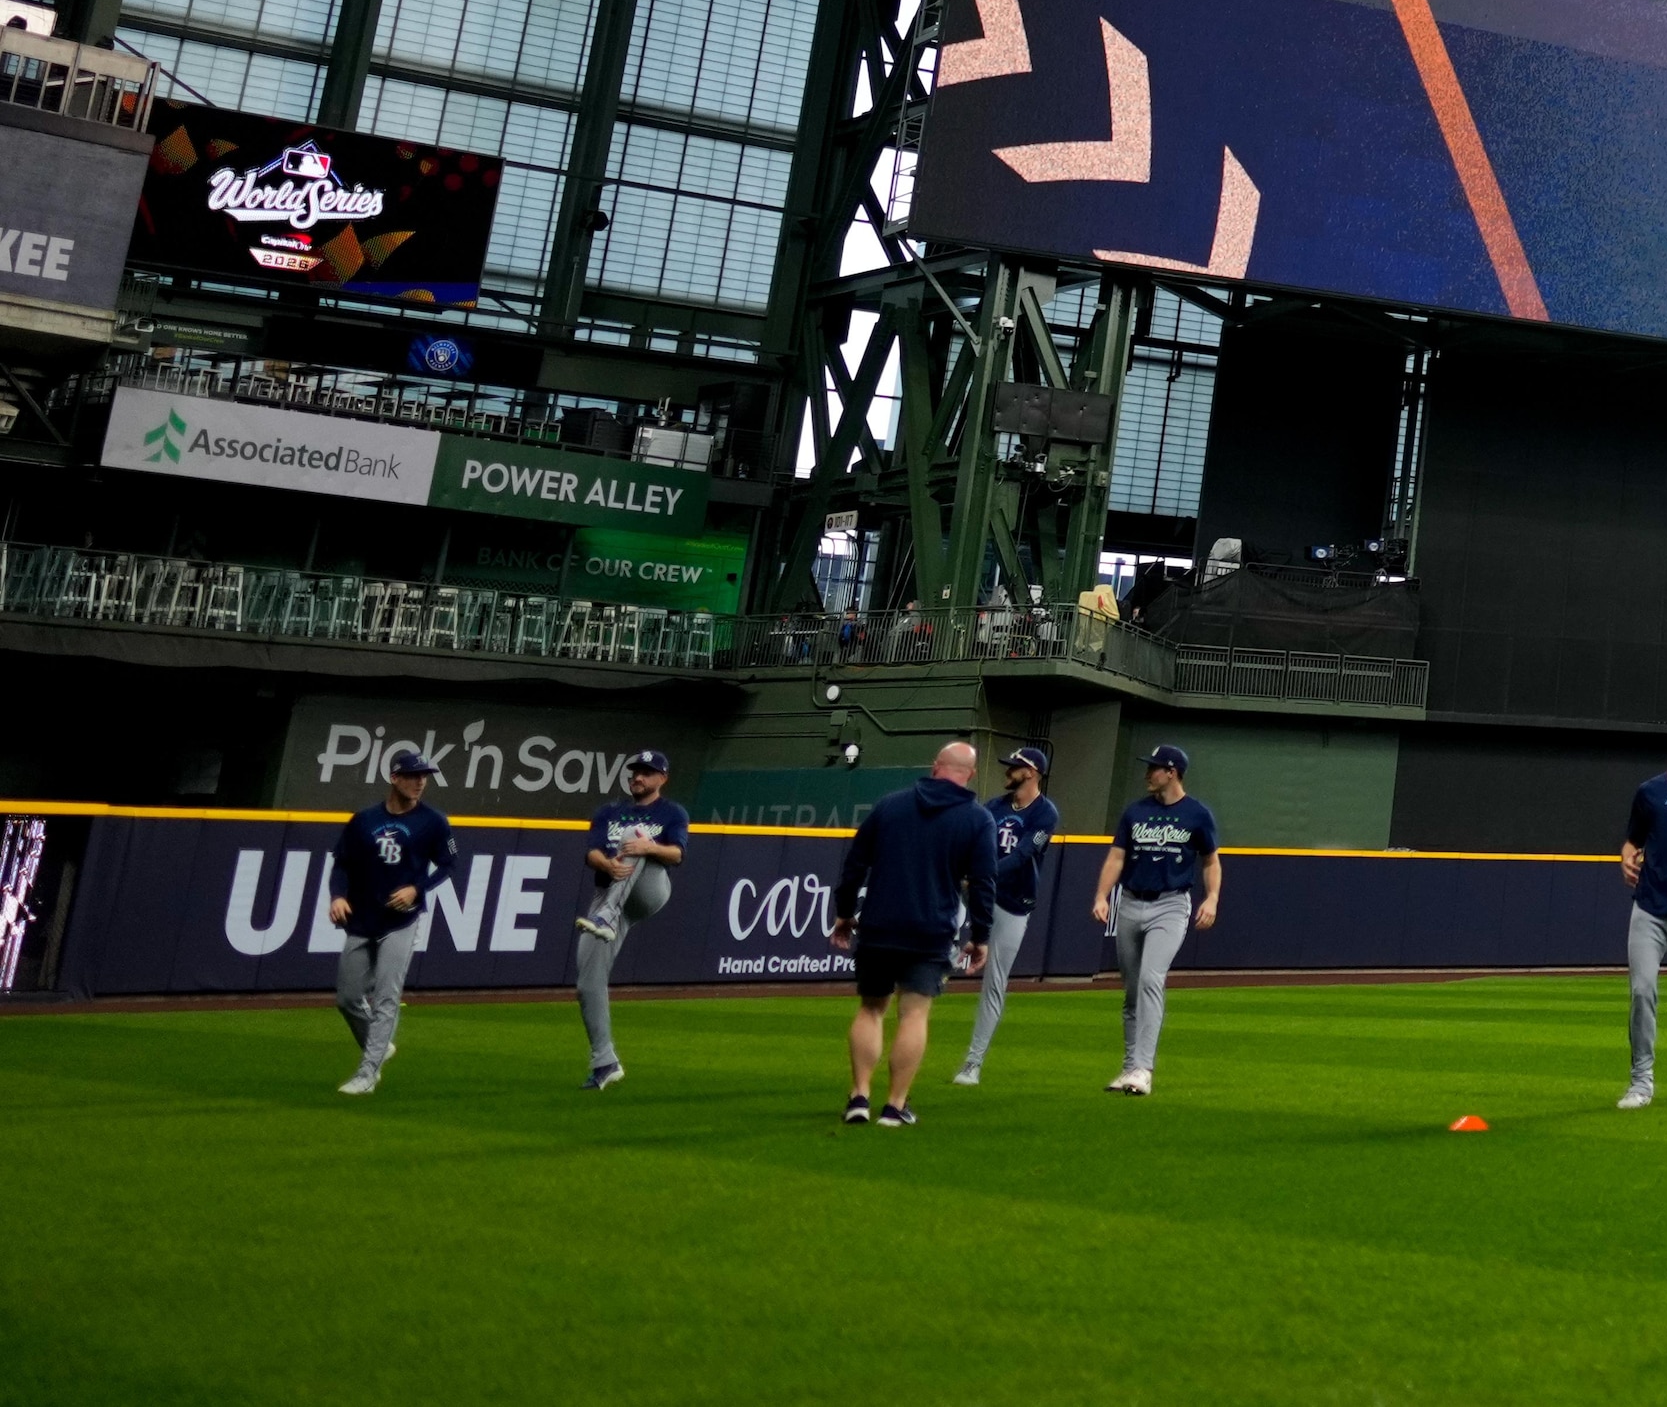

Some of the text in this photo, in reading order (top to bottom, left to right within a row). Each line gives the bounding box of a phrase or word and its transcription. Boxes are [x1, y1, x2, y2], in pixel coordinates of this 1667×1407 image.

[262, 254, 309, 269] 2026
[461, 459, 684, 516] POWER ALLEY
[477, 546, 539, 570] BANK
[585, 556, 633, 578] OUR
[638, 562, 704, 584] CREW
[376, 837, 401, 865] TB
[718, 956, 766, 974] Hand
[767, 955, 831, 974] Crafted
